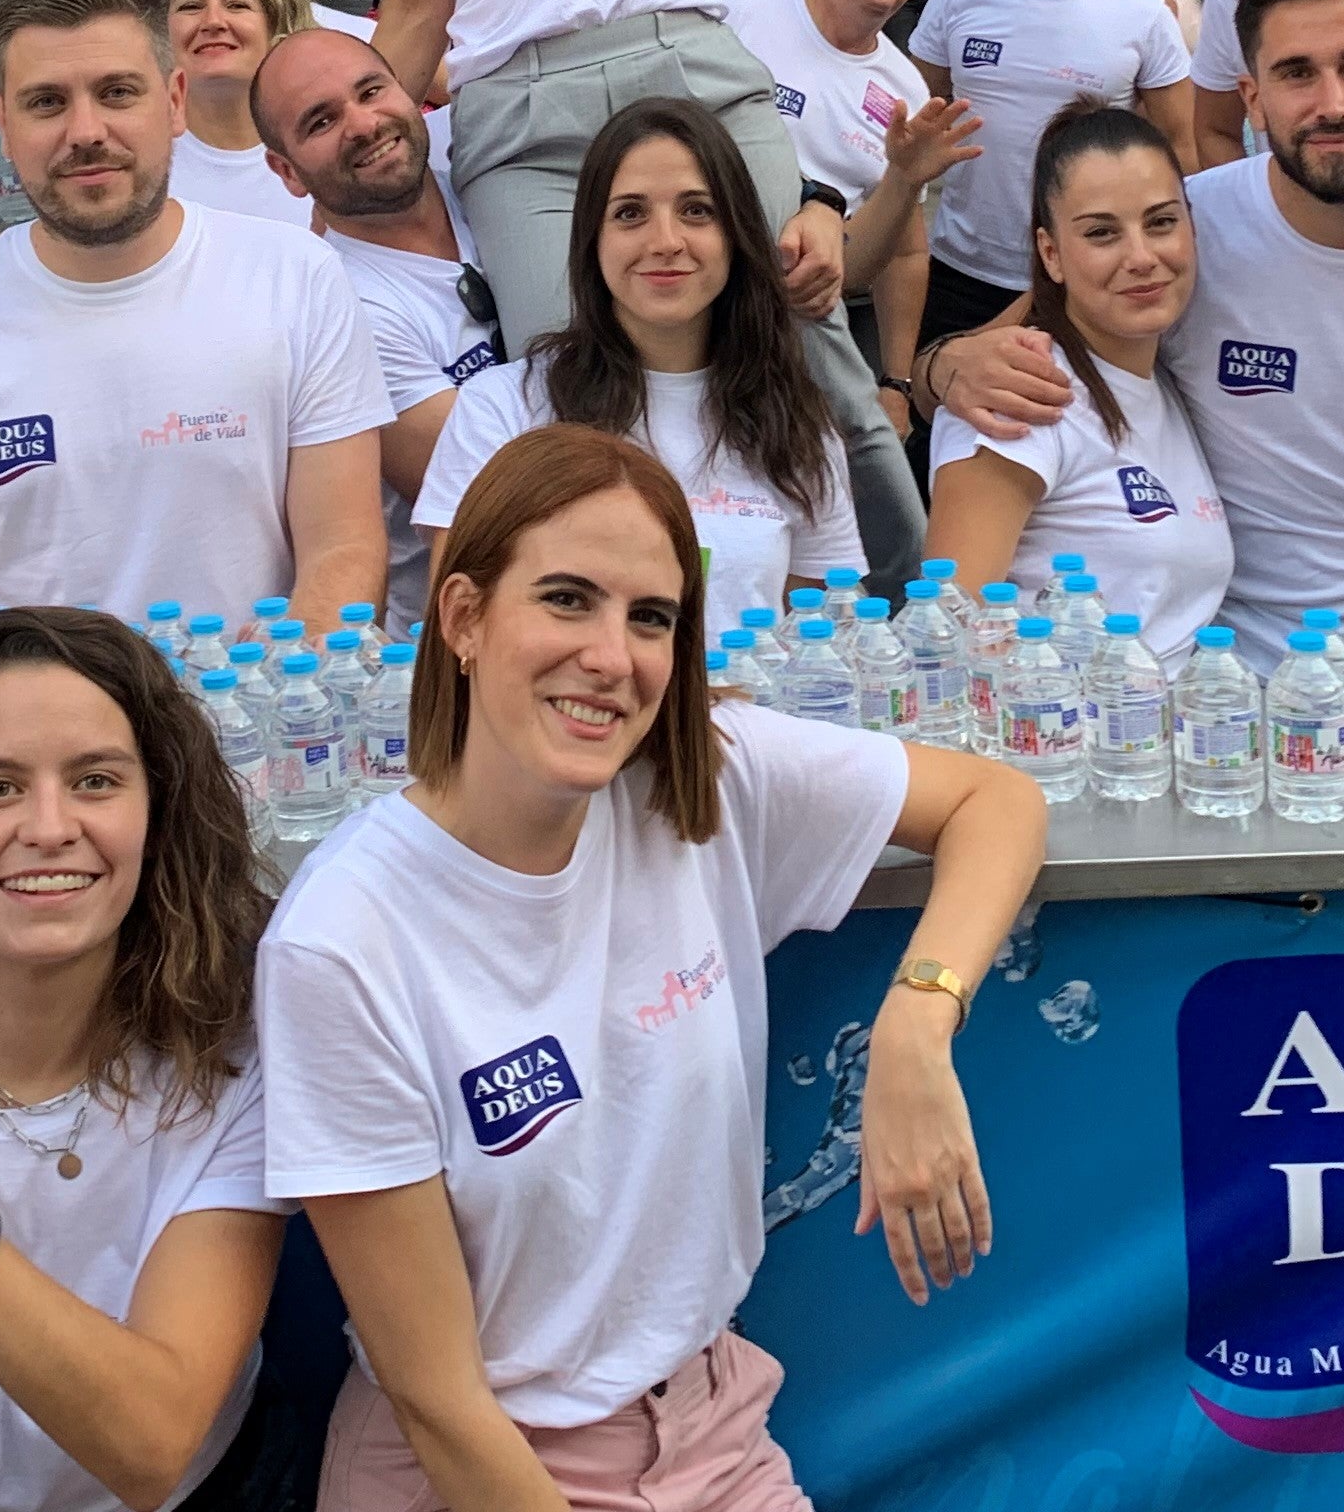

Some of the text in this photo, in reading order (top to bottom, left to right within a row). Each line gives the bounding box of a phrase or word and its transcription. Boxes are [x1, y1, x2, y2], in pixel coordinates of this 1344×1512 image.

[965, 48, 997, 61] DEUS
[966, 40, 999, 53] AQUA
[775, 87, 803, 103] QUA
[775, 97, 800, 112] EUS
[454, 348, 494, 379] QUA
[1225, 346, 1291, 367] AQUA
[1227, 362, 1288, 383] DEUS
[177, 411, 229, 427] Fuente
[194, 425, 246, 442] de Vida
[473, 1047, 559, 1100] AQUA
[481, 1072, 565, 1124] DEUS
[1205, 1338, 1293, 1377] Agua
